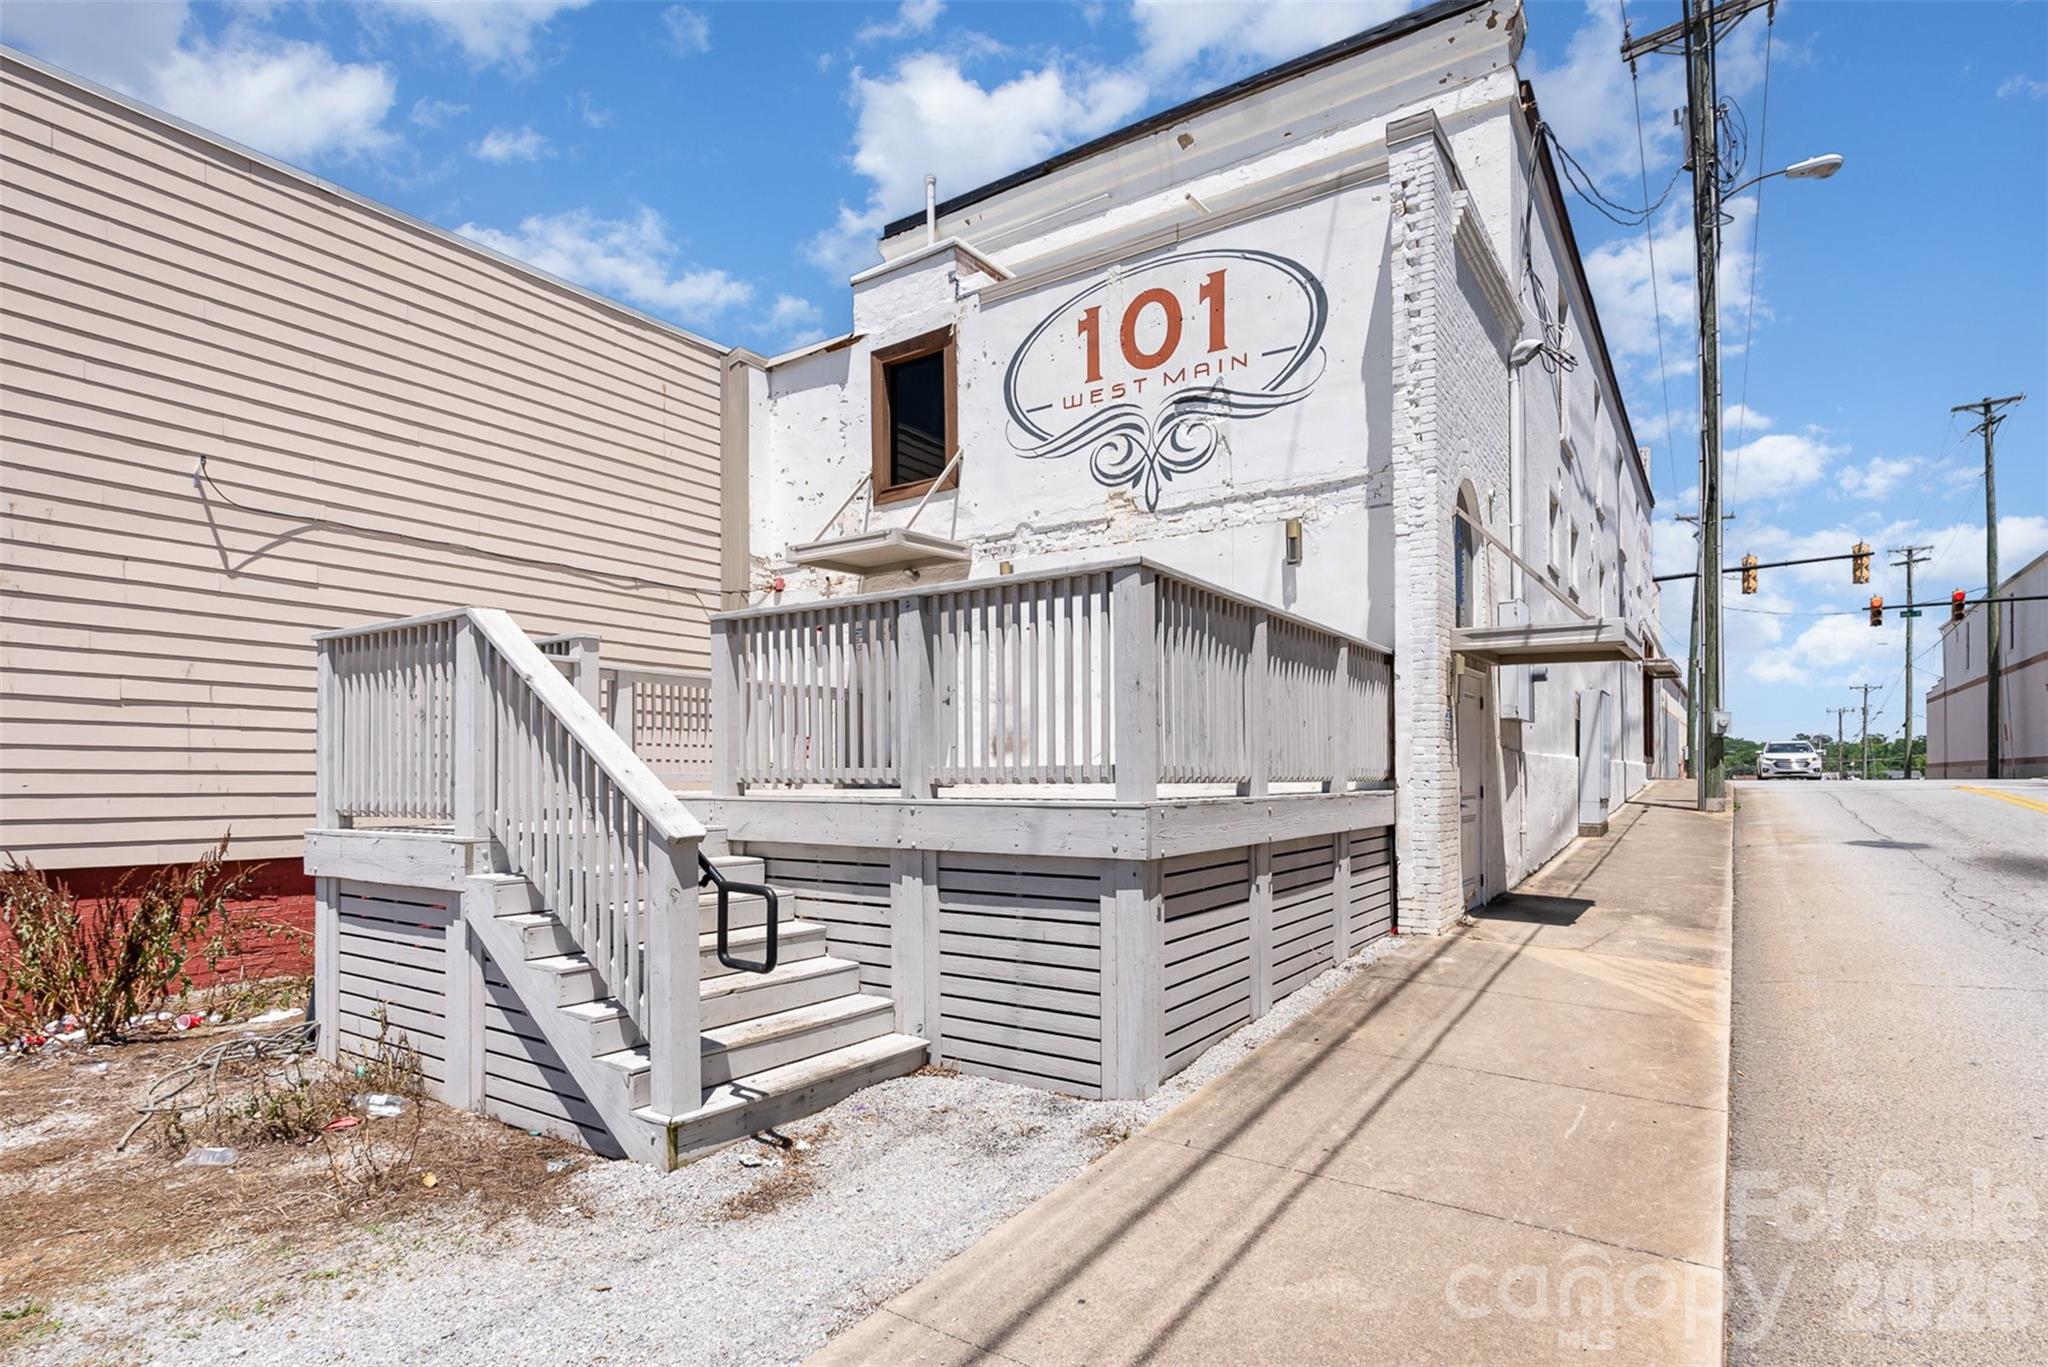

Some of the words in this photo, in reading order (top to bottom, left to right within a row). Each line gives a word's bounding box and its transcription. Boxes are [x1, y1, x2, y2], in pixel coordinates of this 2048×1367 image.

[1078, 269, 1228, 384] 101
[1064, 379, 1147, 409] WEST
[1163, 353, 1248, 386] MAIN
